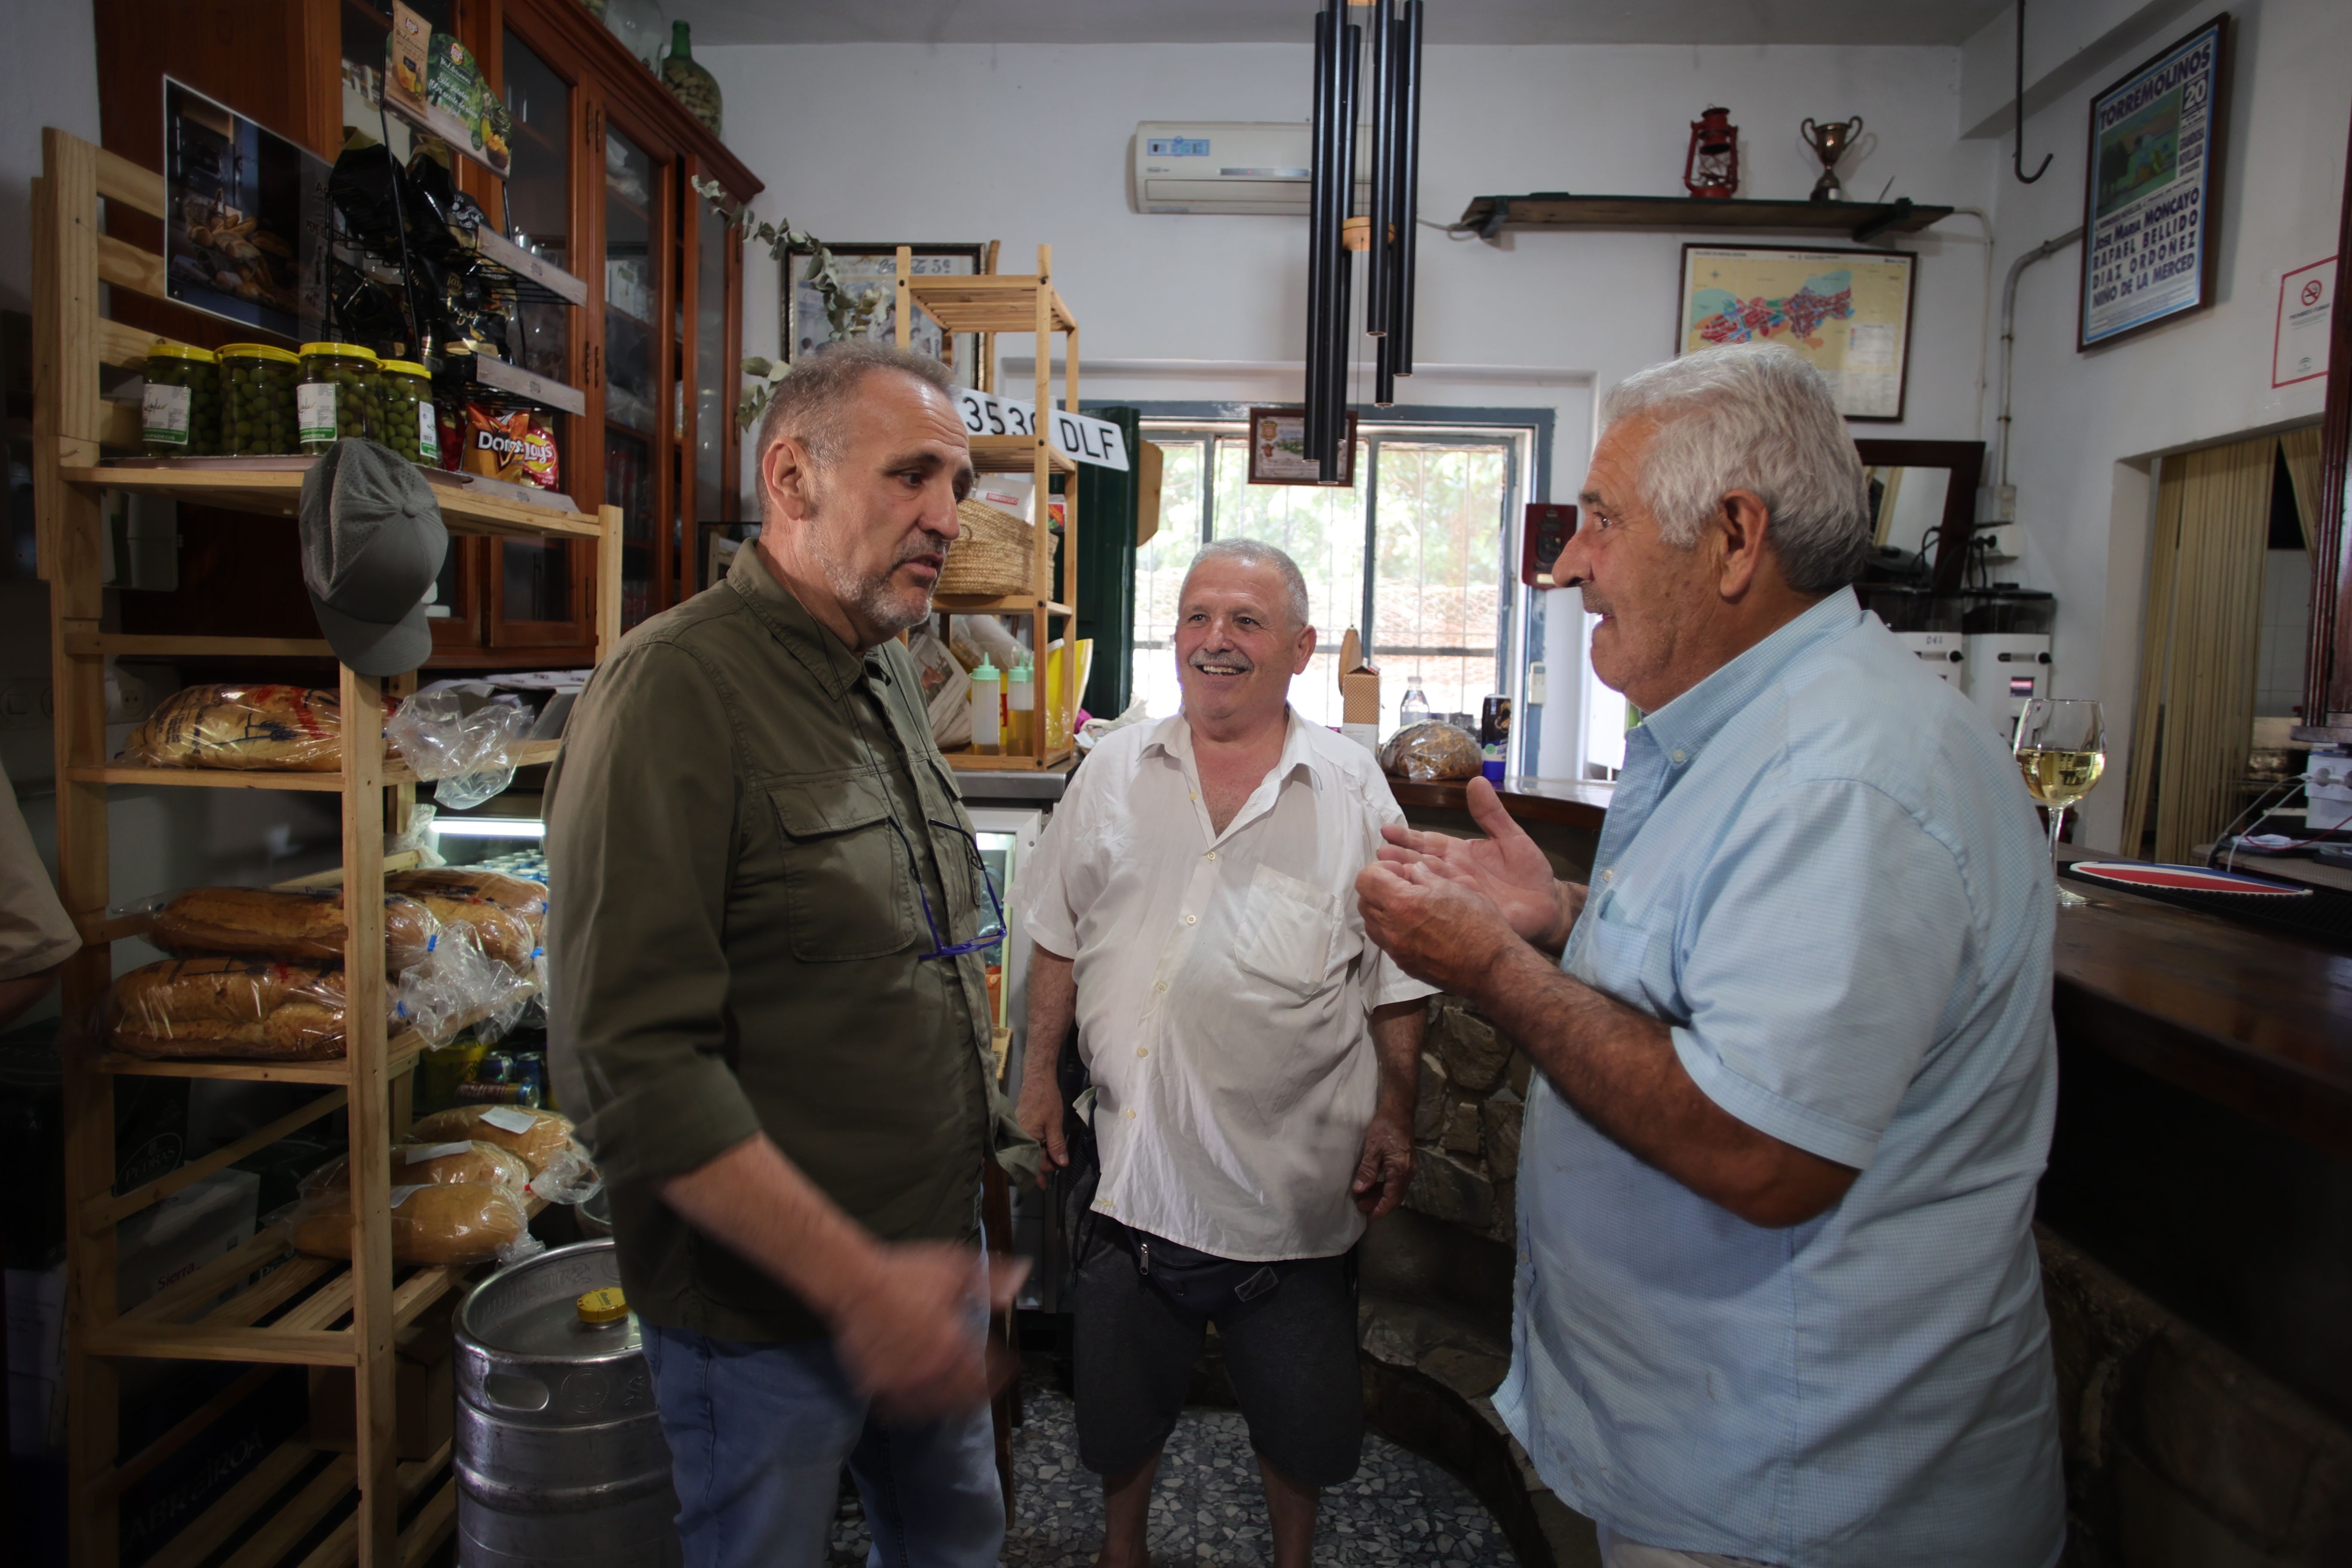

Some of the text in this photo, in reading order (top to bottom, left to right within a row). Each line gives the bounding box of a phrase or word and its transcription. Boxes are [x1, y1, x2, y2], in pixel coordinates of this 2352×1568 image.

[451, 46, 463, 61] Lay's
[2101, 43, 2210, 131] TORREMOLINOS
[2184, 79, 2207, 110] 20
[2144, 187, 2199, 228] MONCAYO
[2093, 239, 2135, 270] RAFAEL
[2142, 209, 2198, 249] BELLIDO
[2093, 230, 2196, 289] DIAZ ORDOÑEZ
[2120, 279, 2132, 297] DE
[2136, 272, 2148, 290] LA
[2151, 253, 2195, 284] MERCED
[524, 441, 553, 464] Lay's
[1059, 417, 1114, 459] DLF
[125, 1145, 176, 1183] PEDRAS
[157, 1262, 195, 1291] Sierra
[119, 1422, 265, 1556] ABREIROÁ
